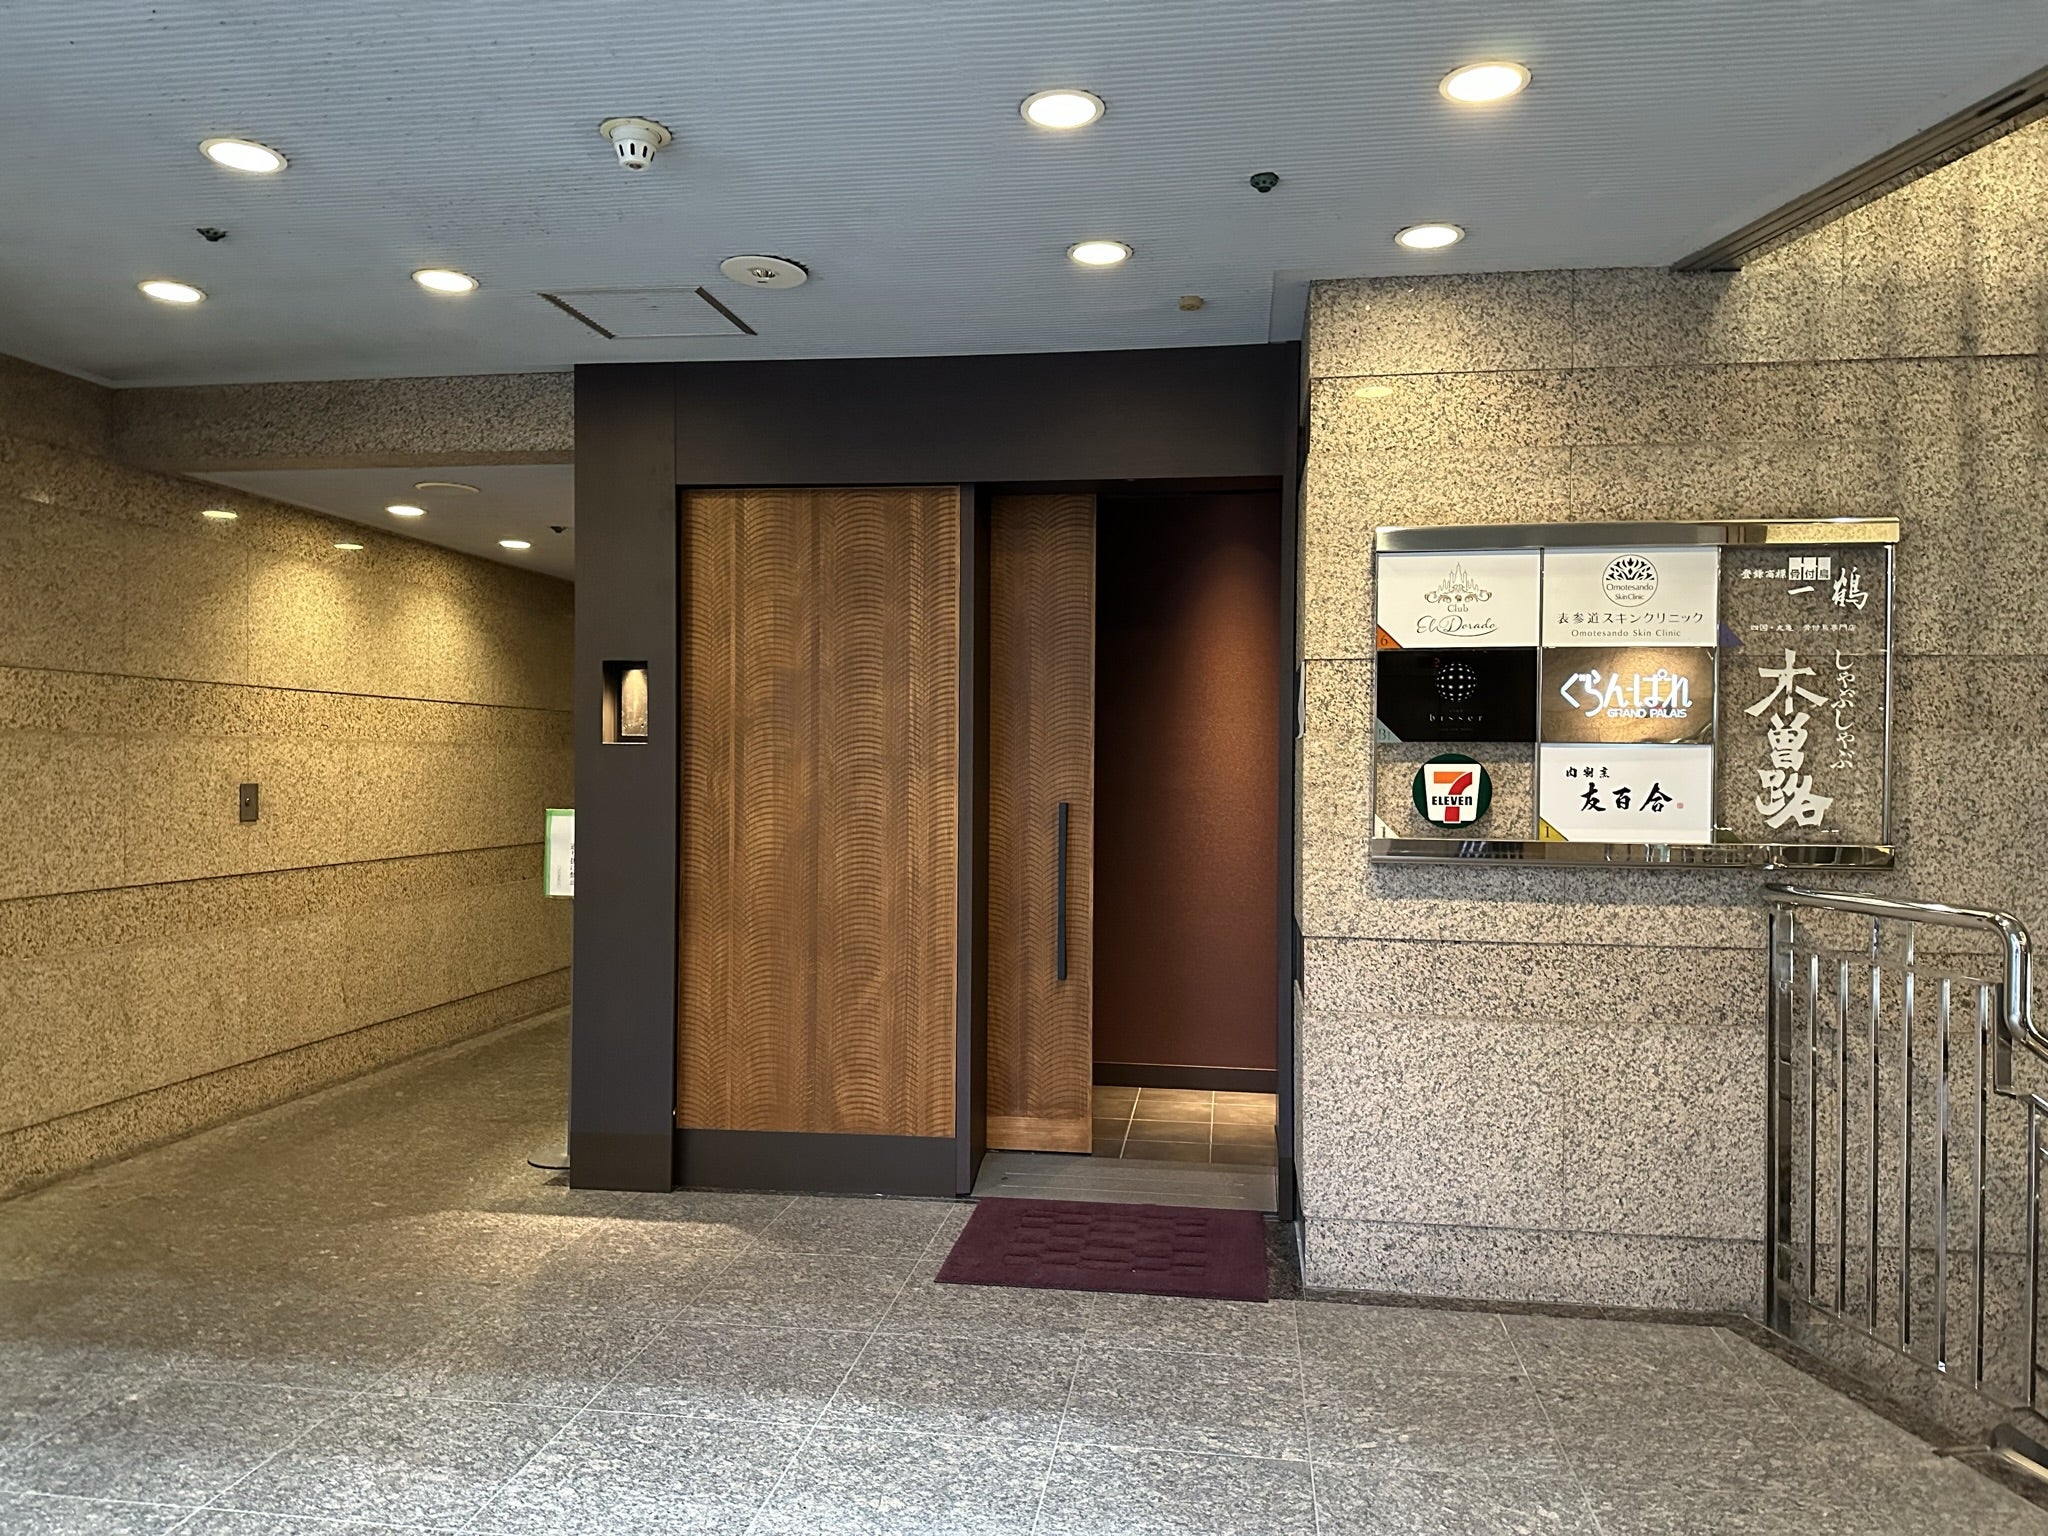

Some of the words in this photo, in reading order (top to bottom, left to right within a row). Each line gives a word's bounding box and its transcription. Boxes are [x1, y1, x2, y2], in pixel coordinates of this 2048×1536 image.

[1606, 583, 1654, 591] Omotesando
[1447, 604, 1469, 613] Club
[1558, 612, 1703, 624] 表参道スキンクリニック
[1571, 629, 1629, 637] Omotesando
[1633, 629, 1651, 637] Skin
[1655, 629, 1680, 637] Clinic
[1380, 636, 1388, 646] 6
[1607, 708, 1647, 718] GRAND
[1650, 708, 1688, 718] PALAIS
[1830, 649, 1856, 769] しゃぶしゃぶ
[1744, 648, 1833, 829] 木曽路
[1580, 782, 1673, 813] 友百合
